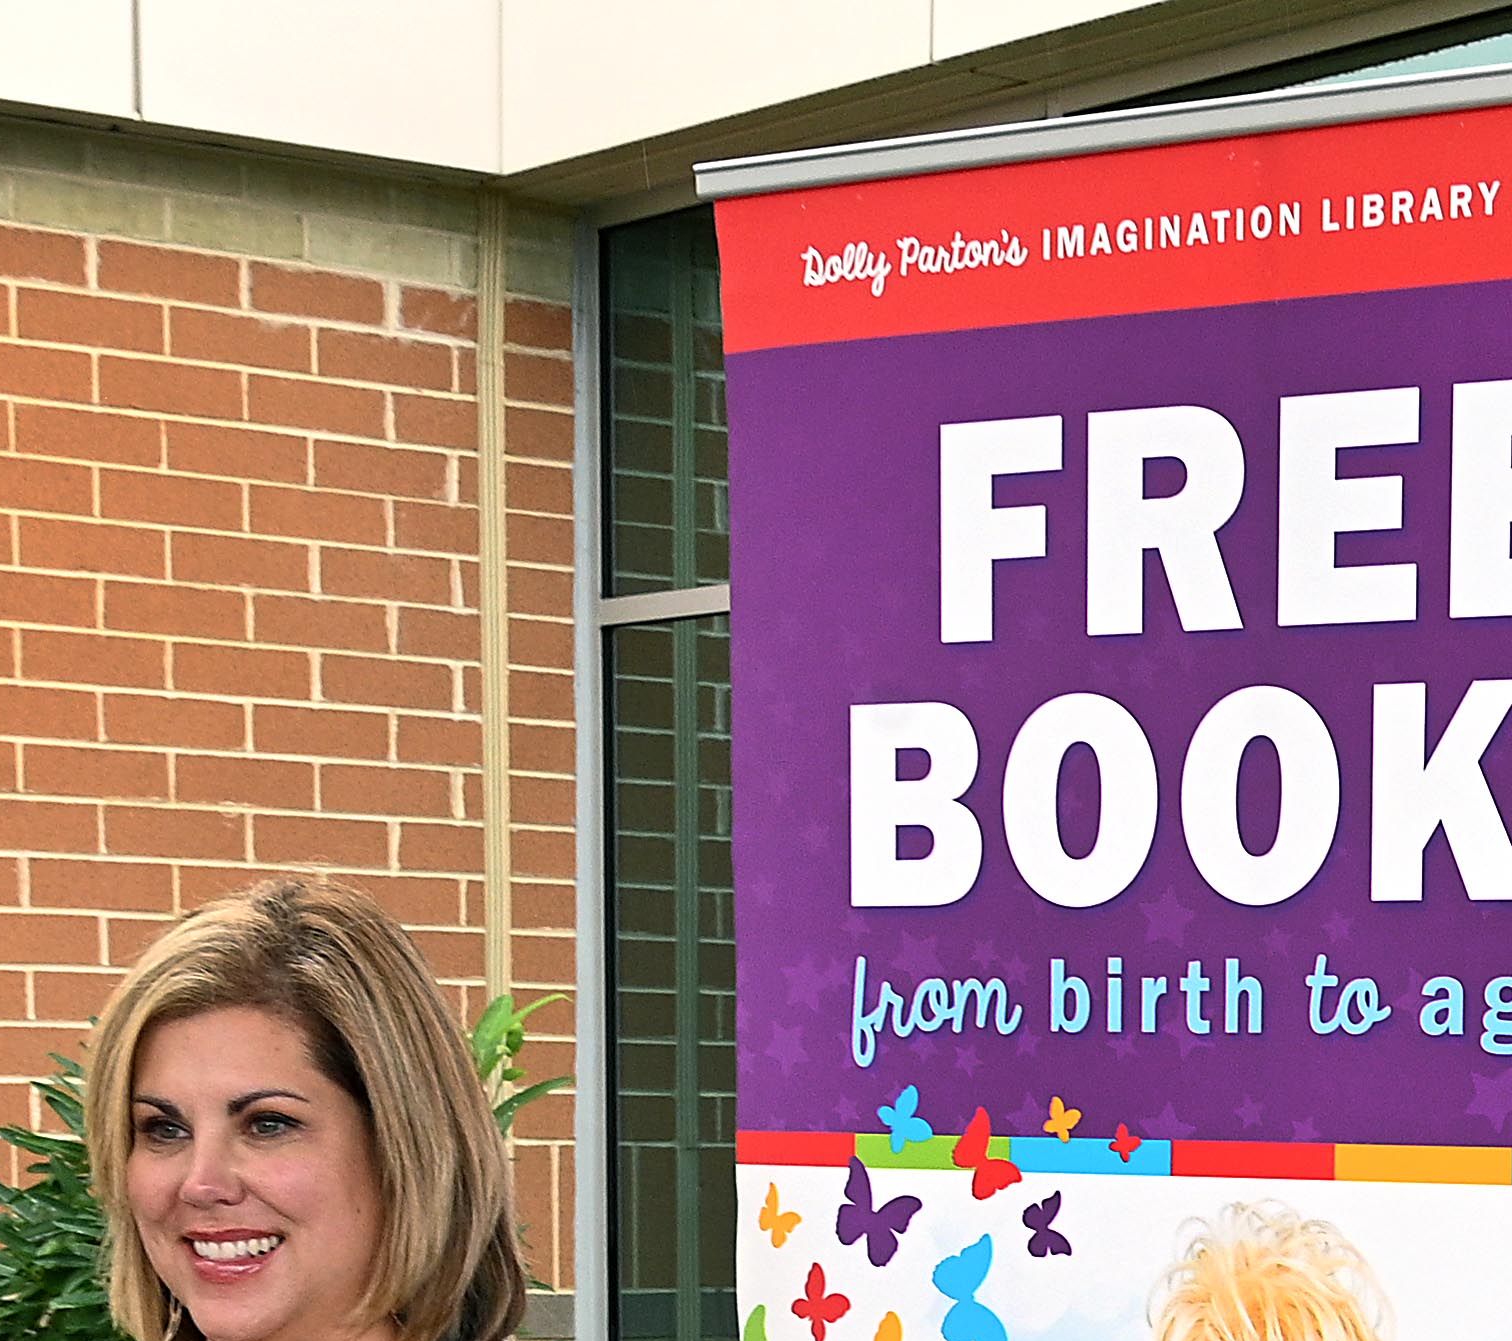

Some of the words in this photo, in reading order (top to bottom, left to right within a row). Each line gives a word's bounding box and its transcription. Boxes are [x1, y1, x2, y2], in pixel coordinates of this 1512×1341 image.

[802, 245, 890, 298] Dolly
[897, 228, 1027, 279] Parton's
[1041, 203, 1301, 261] IMAGINATION
[1320, 180, 1501, 233] LIBRARY
[852, 956, 1022, 1068] from
[1049, 958, 1263, 1036] birth
[1304, 953, 1391, 1036] to
